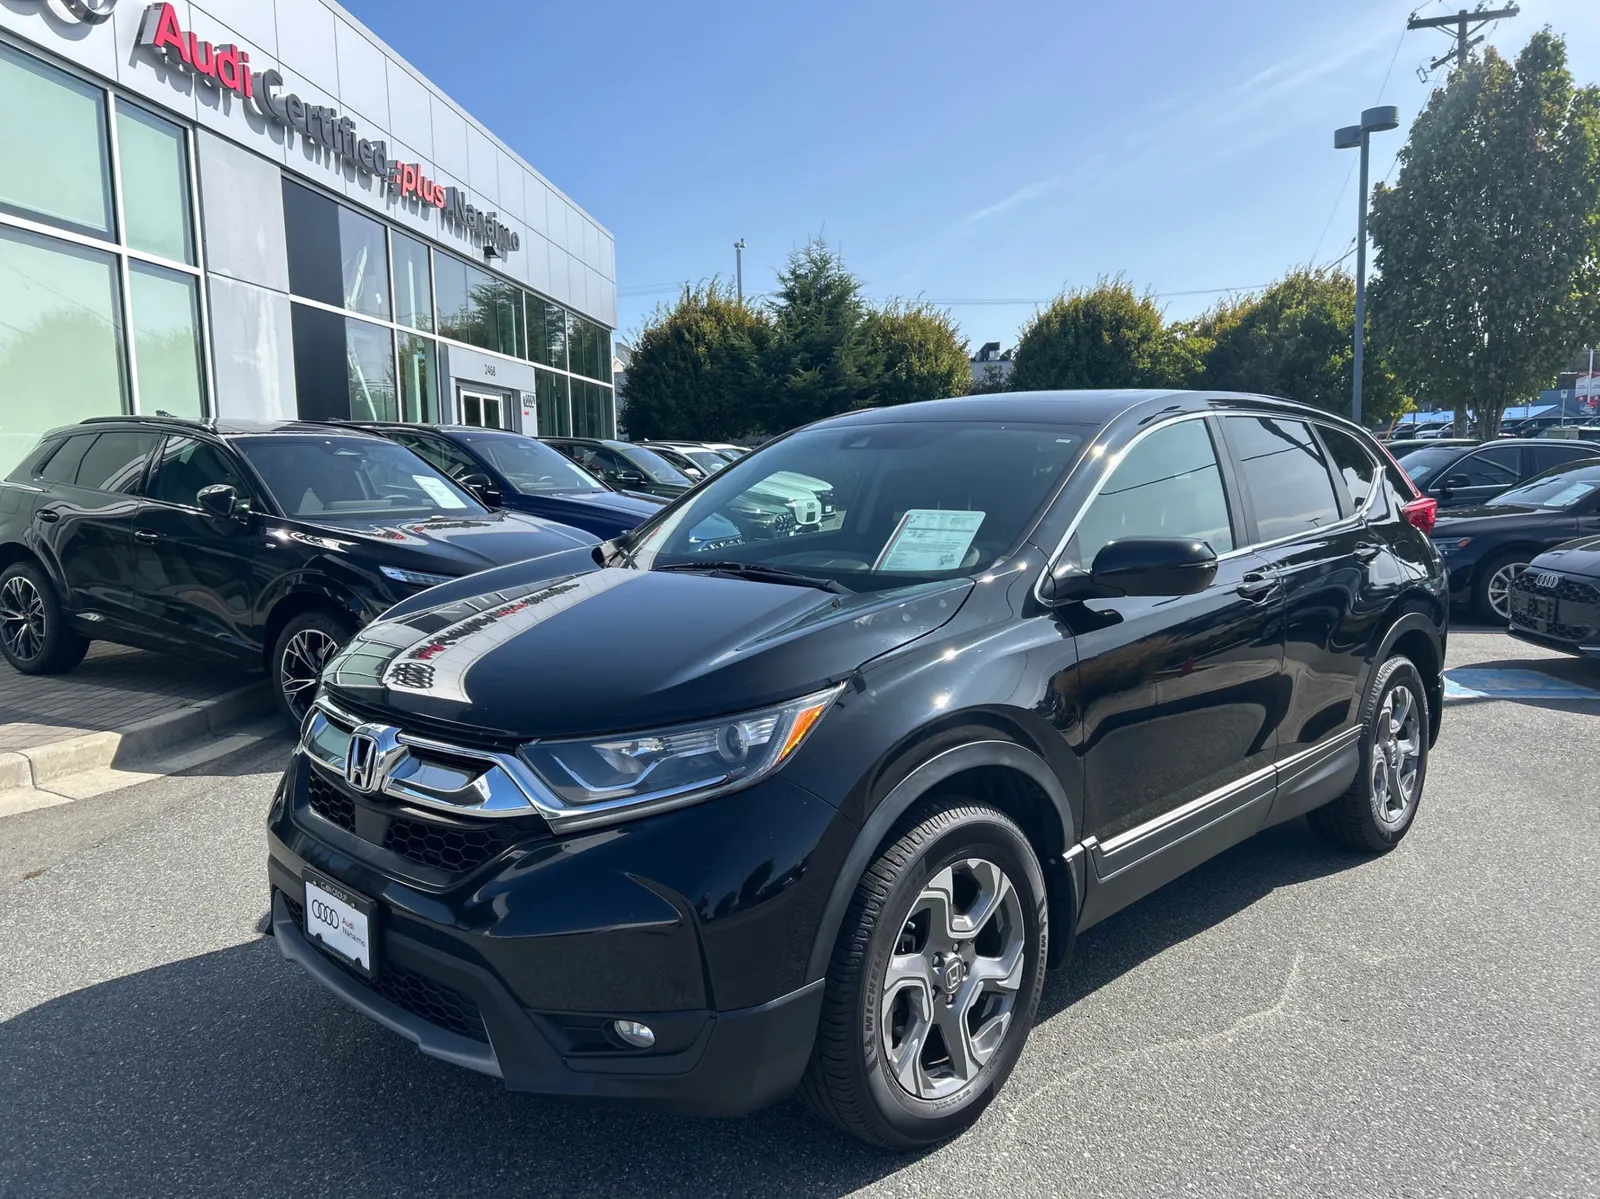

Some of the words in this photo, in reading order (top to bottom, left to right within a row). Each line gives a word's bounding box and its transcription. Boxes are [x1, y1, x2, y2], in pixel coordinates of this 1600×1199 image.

[152, 2, 253, 98] Audi
[257, 68, 388, 177] Certified
[450, 186, 521, 251] Nanaimo
[484, 364, 496, 376] 2468
[342, 917, 355, 931] Audi
[342, 926, 366, 947] Nanaimo
[865, 939, 886, 1035] MICHELIN
